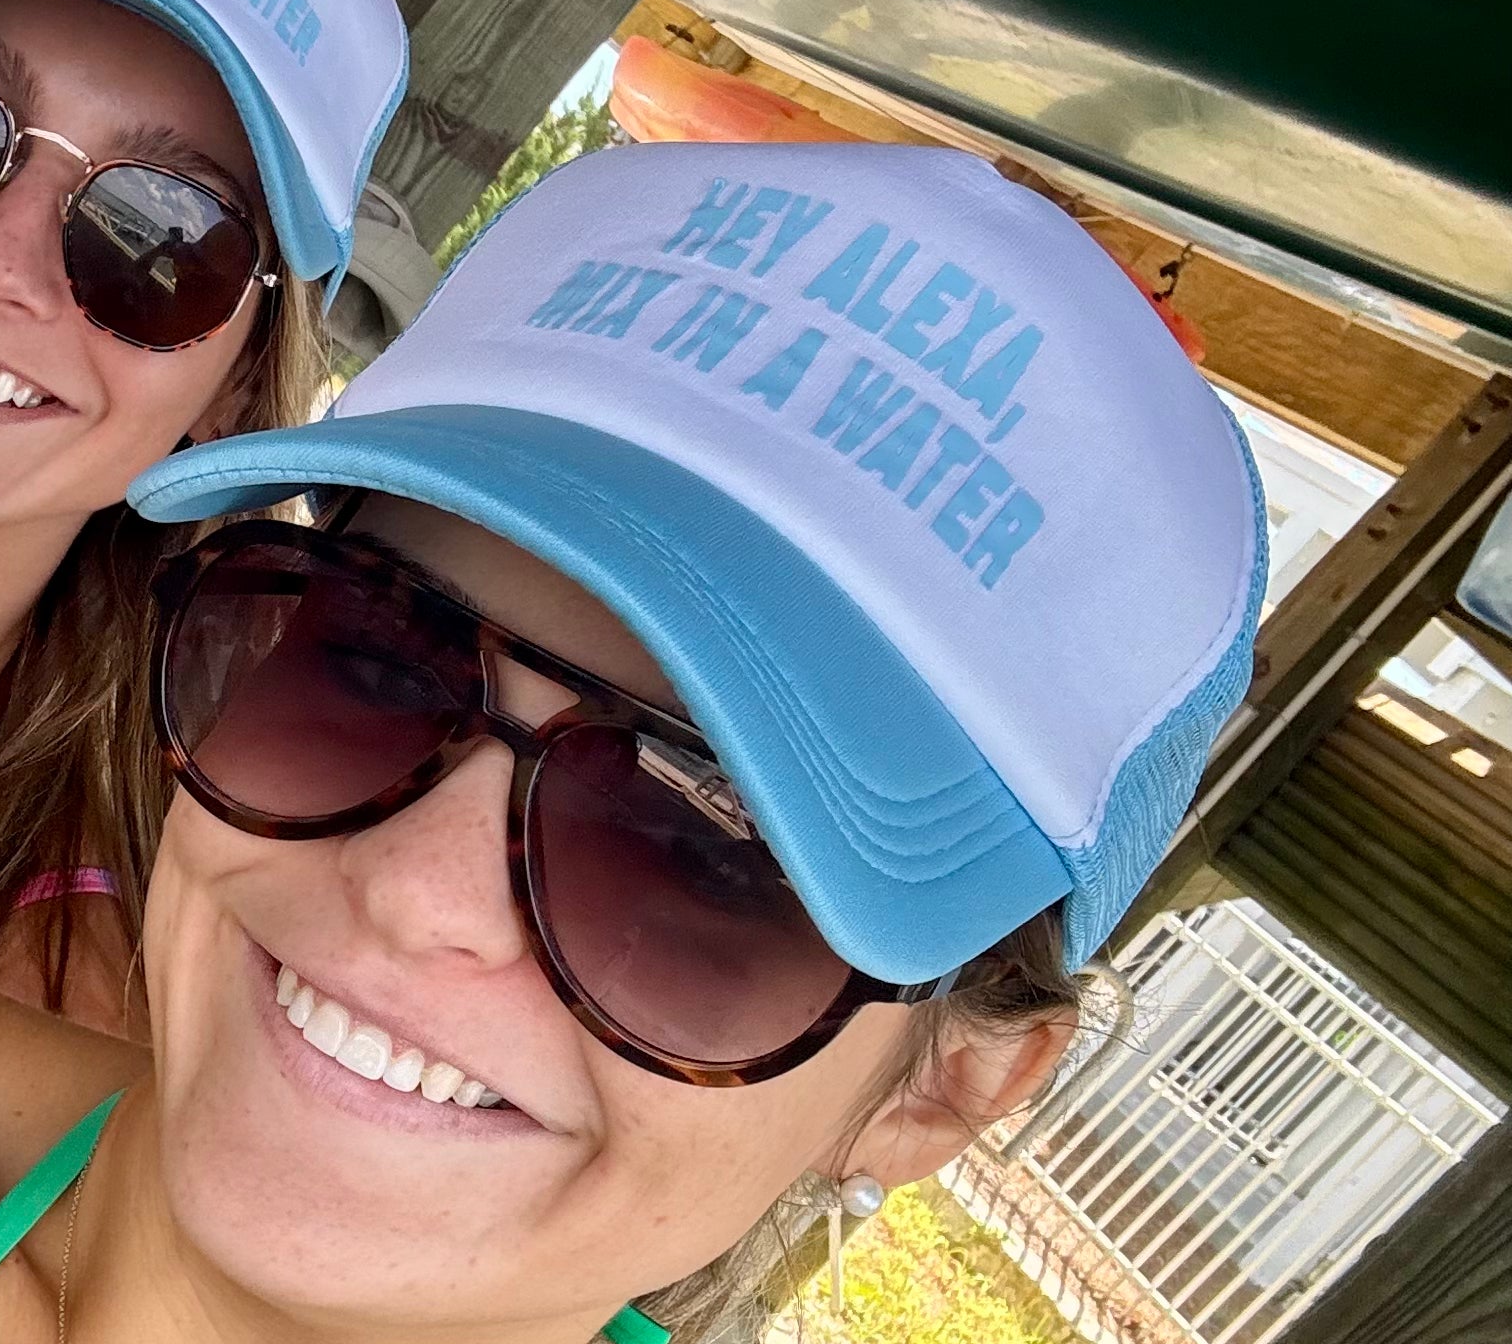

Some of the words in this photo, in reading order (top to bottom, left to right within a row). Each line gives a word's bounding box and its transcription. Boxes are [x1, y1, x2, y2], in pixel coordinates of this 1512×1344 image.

[526, 260, 683, 340] MIX
[651, 285, 772, 374] IN
[740, 327, 829, 413] A
[811, 358, 1047, 592] WATER
[661, 176, 835, 279] HEY
[801, 222, 1047, 445] ALEXA,
